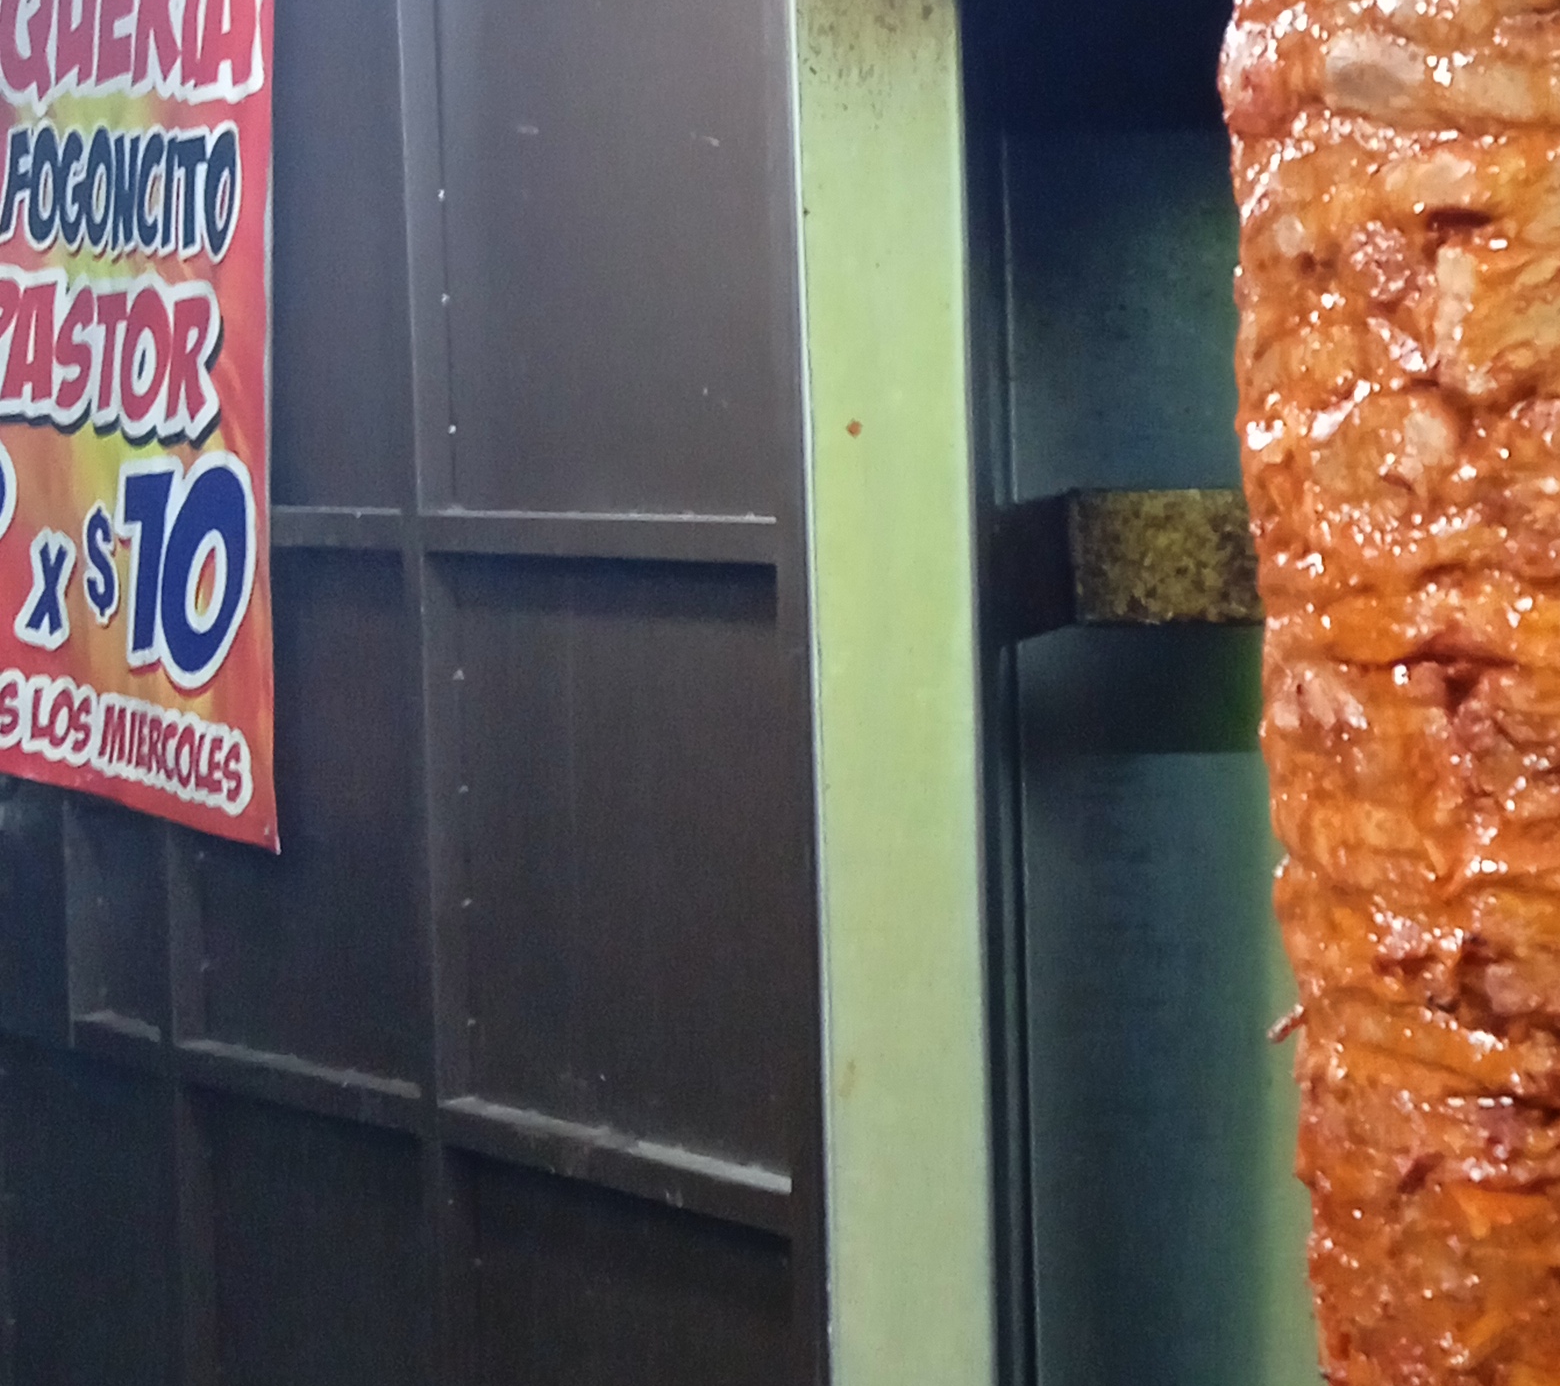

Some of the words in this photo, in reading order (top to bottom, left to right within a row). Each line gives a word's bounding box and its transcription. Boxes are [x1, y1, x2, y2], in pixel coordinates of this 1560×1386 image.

[0, 124, 239, 257] FOGONCITO
[85, 463, 249, 676] $10
[30, 686, 93, 755] LOS
[97, 702, 245, 804] MIERCOLES
